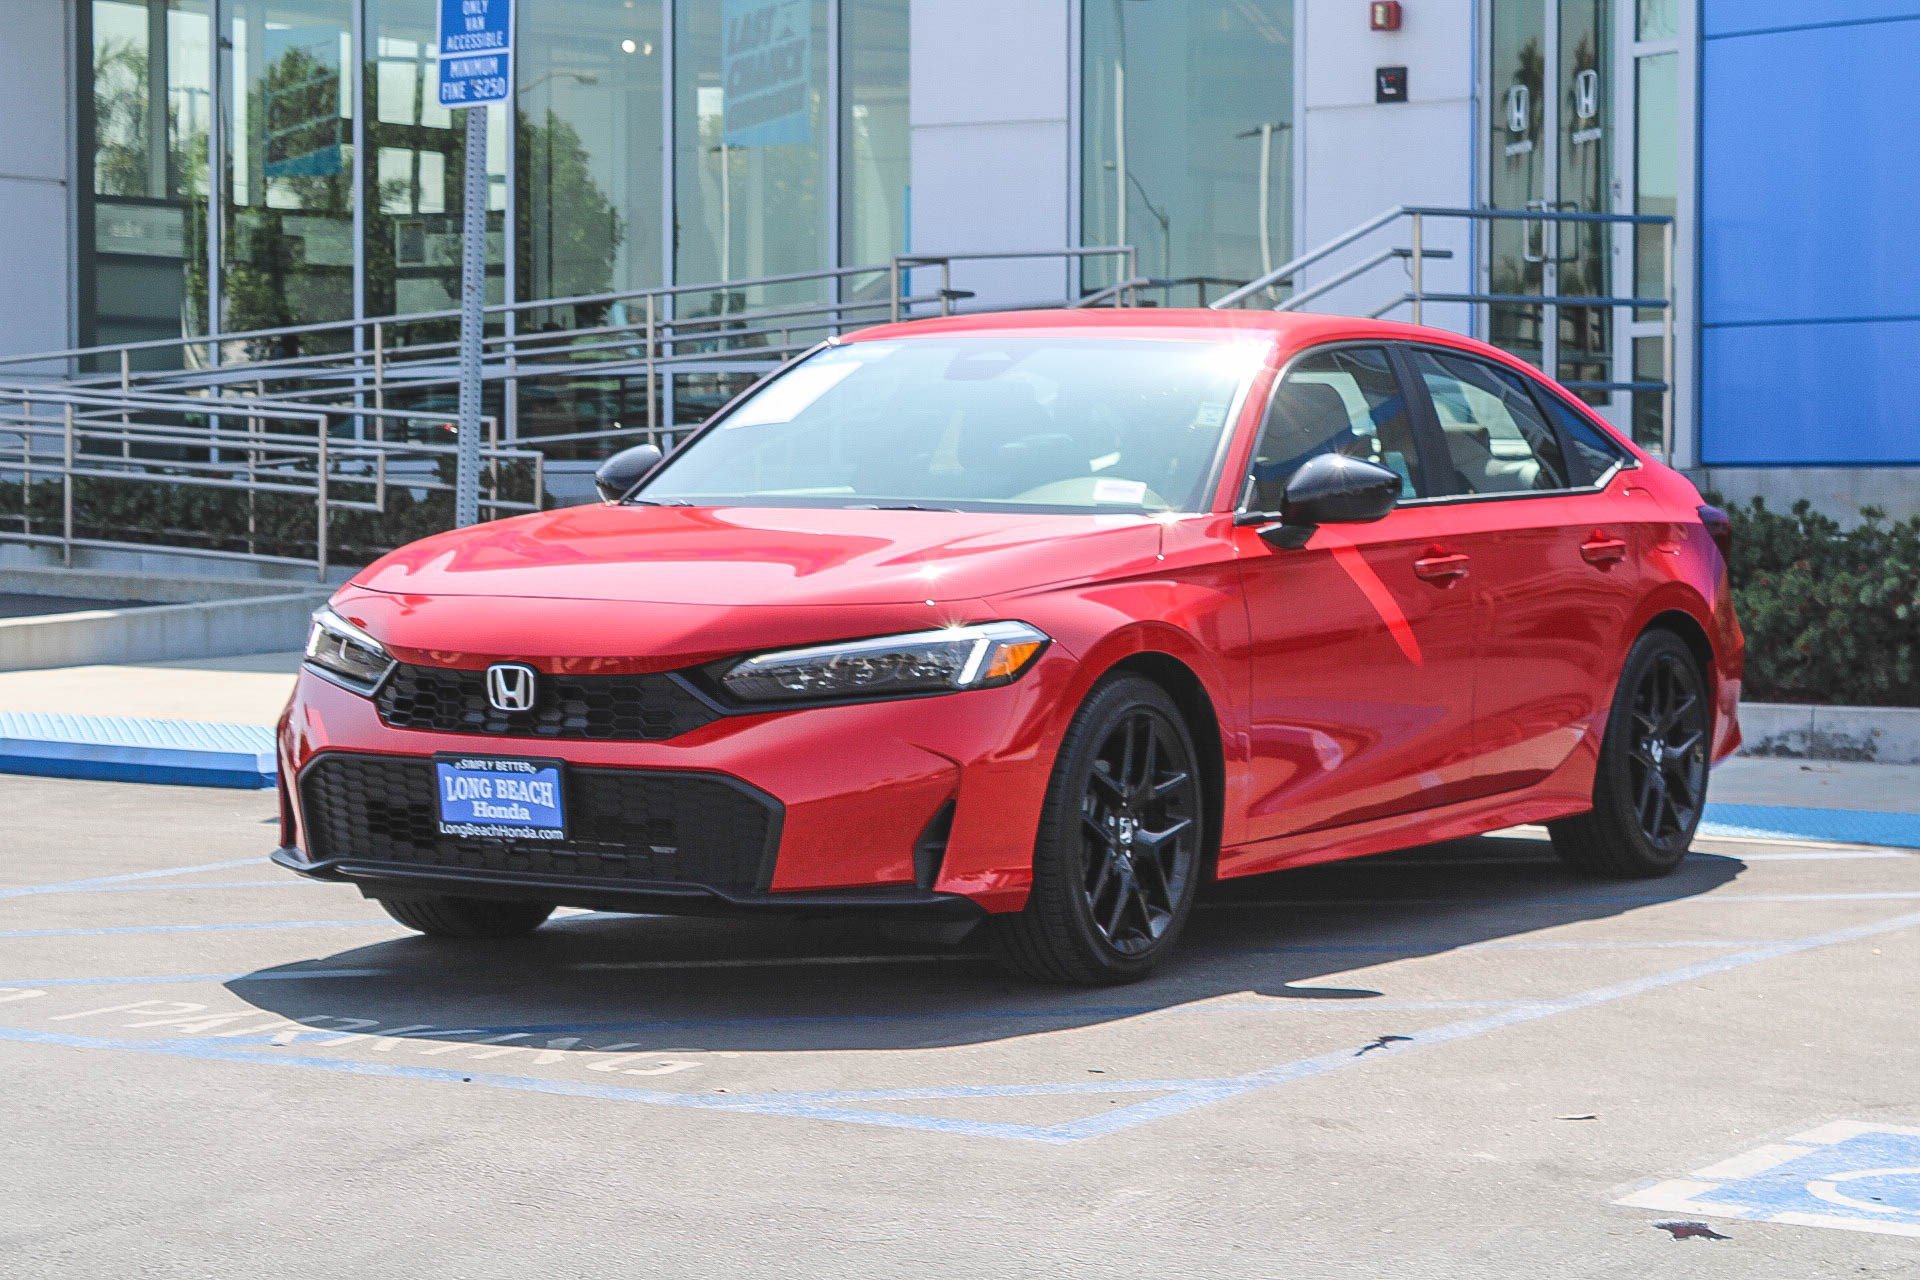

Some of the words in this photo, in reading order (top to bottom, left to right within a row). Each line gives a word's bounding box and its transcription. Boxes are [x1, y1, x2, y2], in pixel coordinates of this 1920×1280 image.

[462, 0, 488, 15] ONLY
[464, 16, 485, 31] VAN
[446, 31, 503, 50] ACCESSIBLE
[450, 56, 498, 78] MINIMUM
[441, 80, 466, 100] FINE
[460, 759, 493, 771] SIMPLY
[495, 761, 531, 772] BETTER
[444, 776, 492, 801] LONG
[495, 779, 555, 808] BEACH
[472, 801, 532, 821] Honda
[439, 820, 564, 840] LongBeachHonda.com
